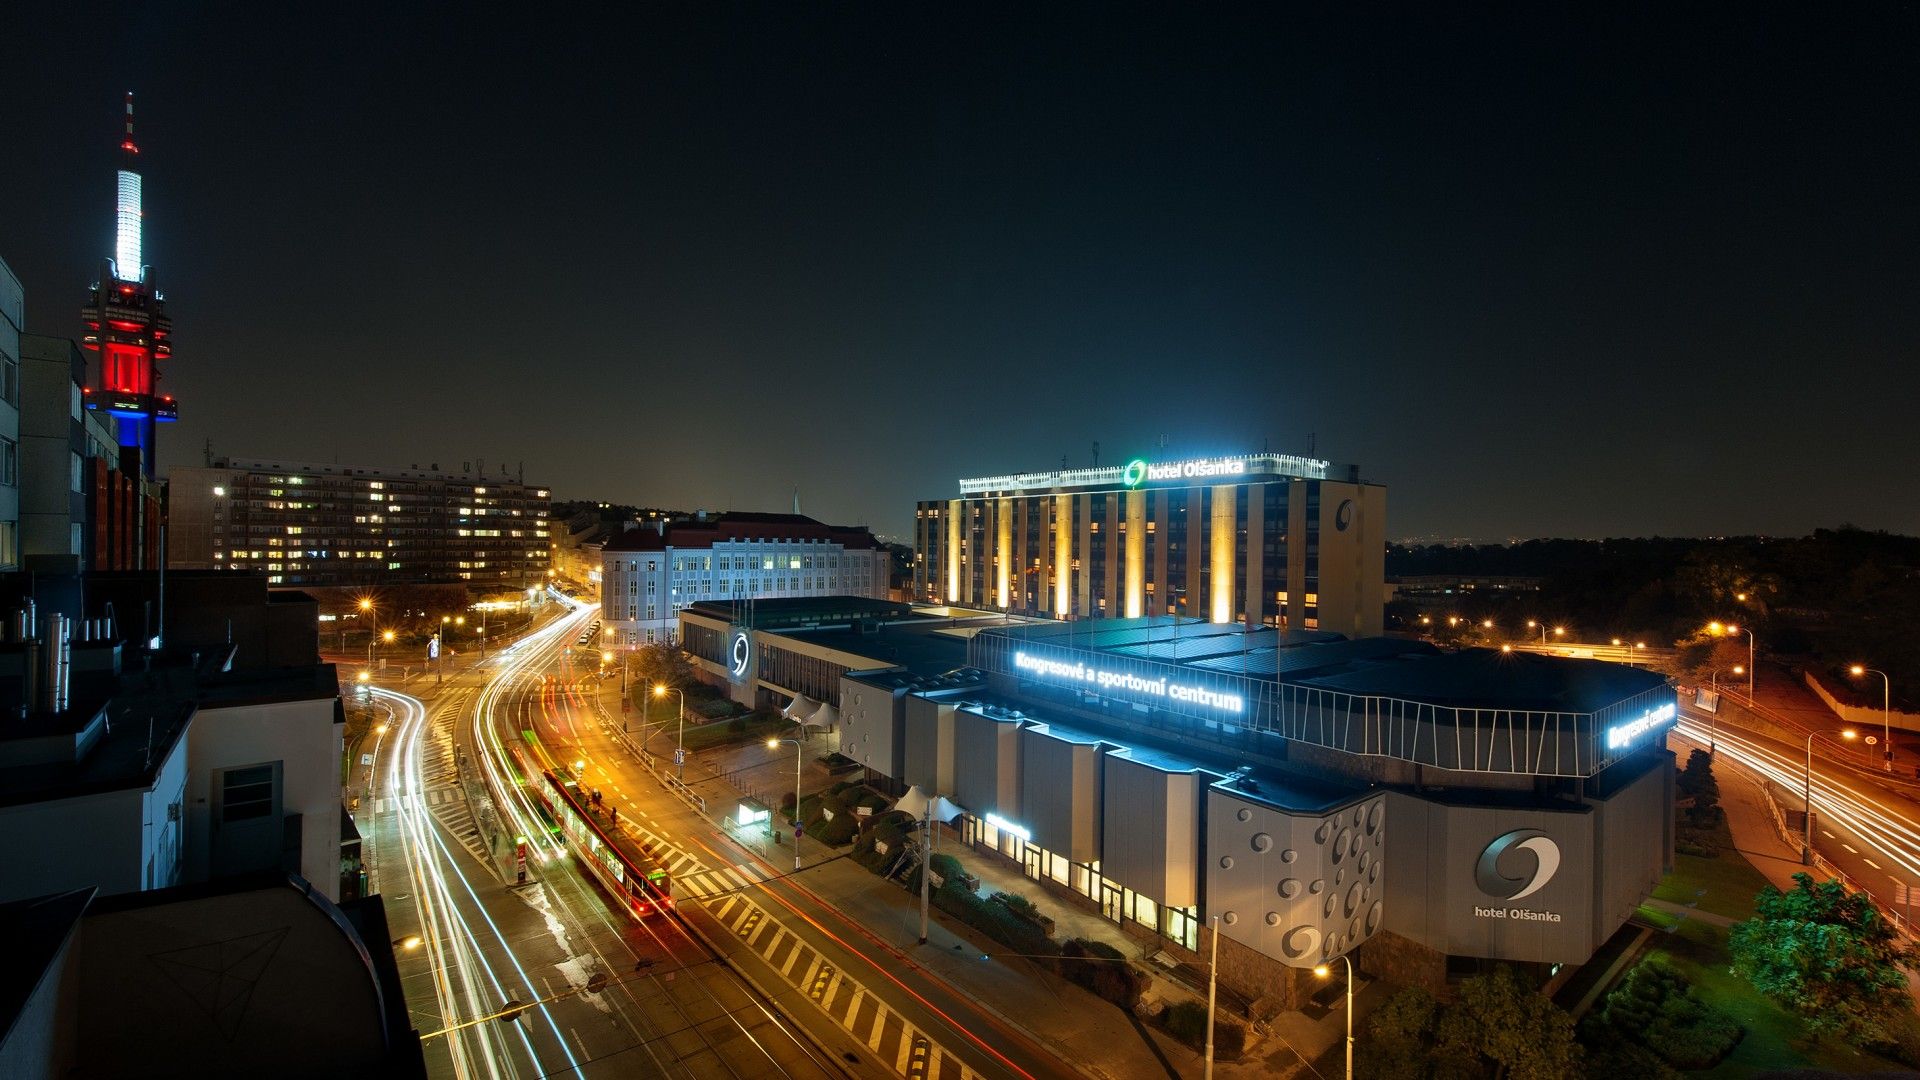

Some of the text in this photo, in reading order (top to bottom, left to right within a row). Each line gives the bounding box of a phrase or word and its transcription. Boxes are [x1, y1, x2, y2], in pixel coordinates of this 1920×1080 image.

[1147, 459, 1244, 480] hotel Olšanka
[1016, 652, 1242, 711] Kongresové a sportovní centrum
[1474, 906, 1562, 922] hotel Olšanka
